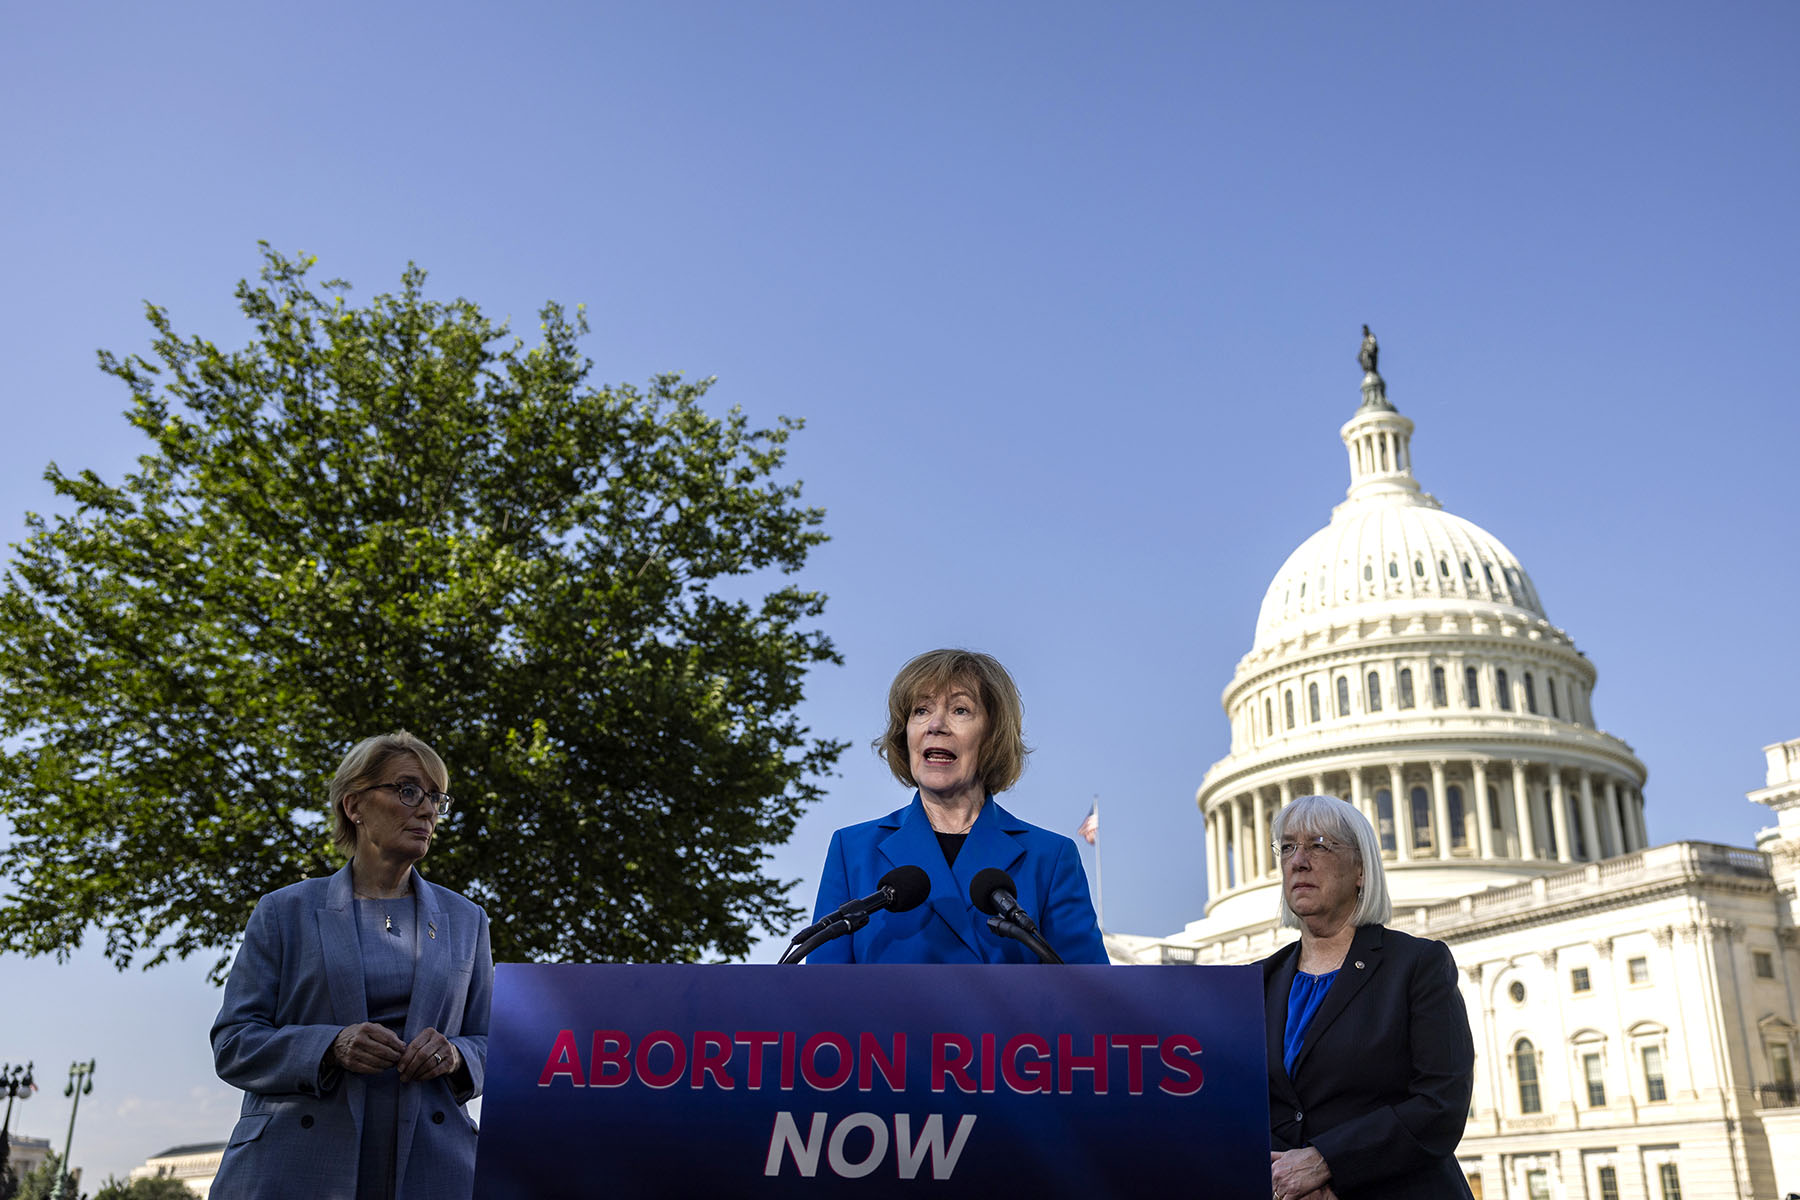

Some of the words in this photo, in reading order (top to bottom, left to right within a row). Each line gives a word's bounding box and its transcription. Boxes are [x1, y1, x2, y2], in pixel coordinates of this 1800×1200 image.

[538, 1031, 906, 1092] ABORTION
[932, 1034, 1204, 1096] RIGHTS
[765, 1112, 977, 1180] NOW
